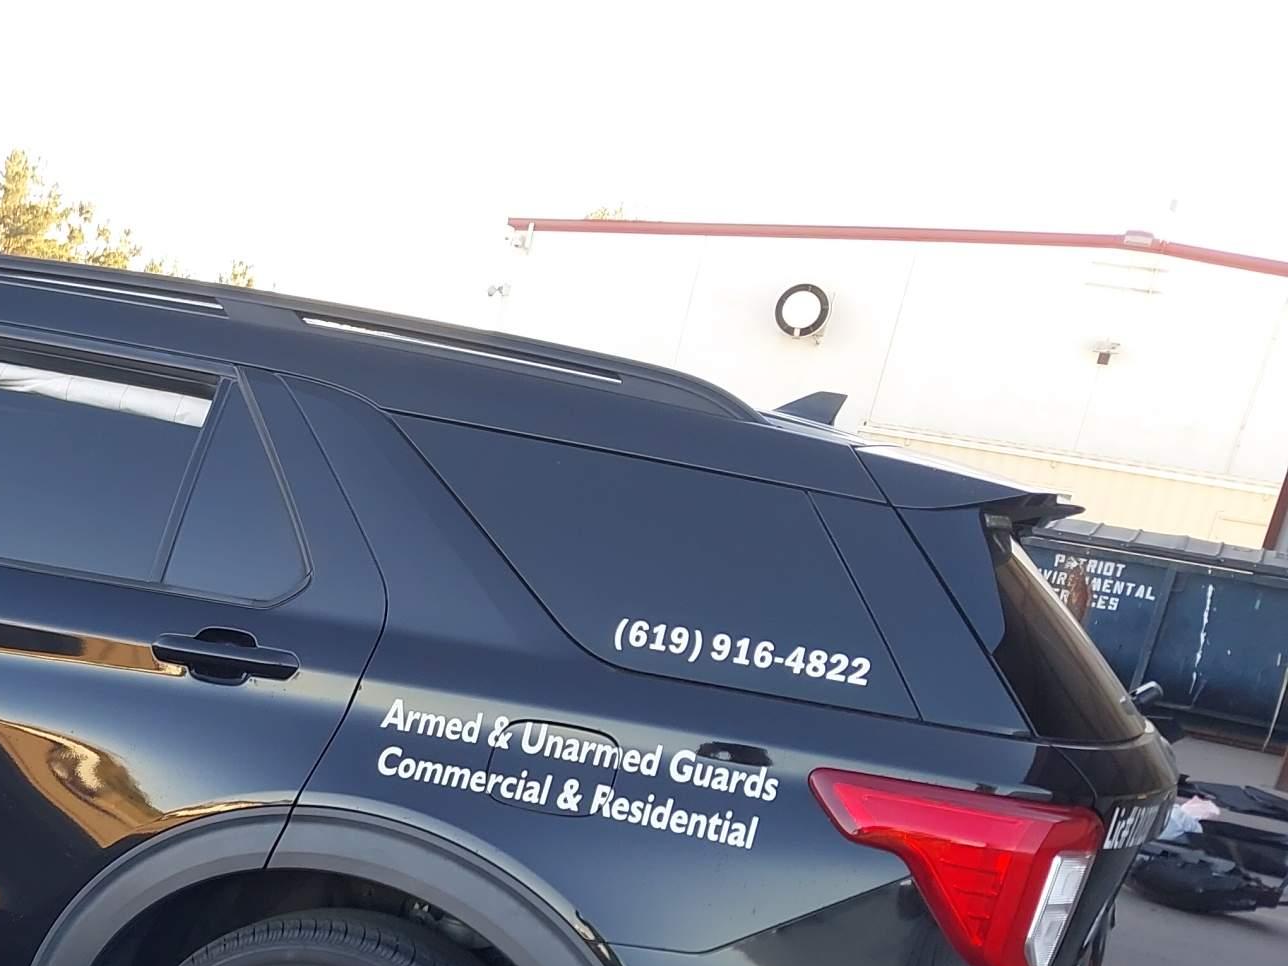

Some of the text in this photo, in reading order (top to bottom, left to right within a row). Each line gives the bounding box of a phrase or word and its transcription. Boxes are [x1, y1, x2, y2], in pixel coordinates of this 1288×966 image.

[614, 618, 871, 686] (619) 916-4822
[377, 746, 759, 849] Commercial & Residential
[380, 698, 779, 802] Armed & Unarmed Guards
